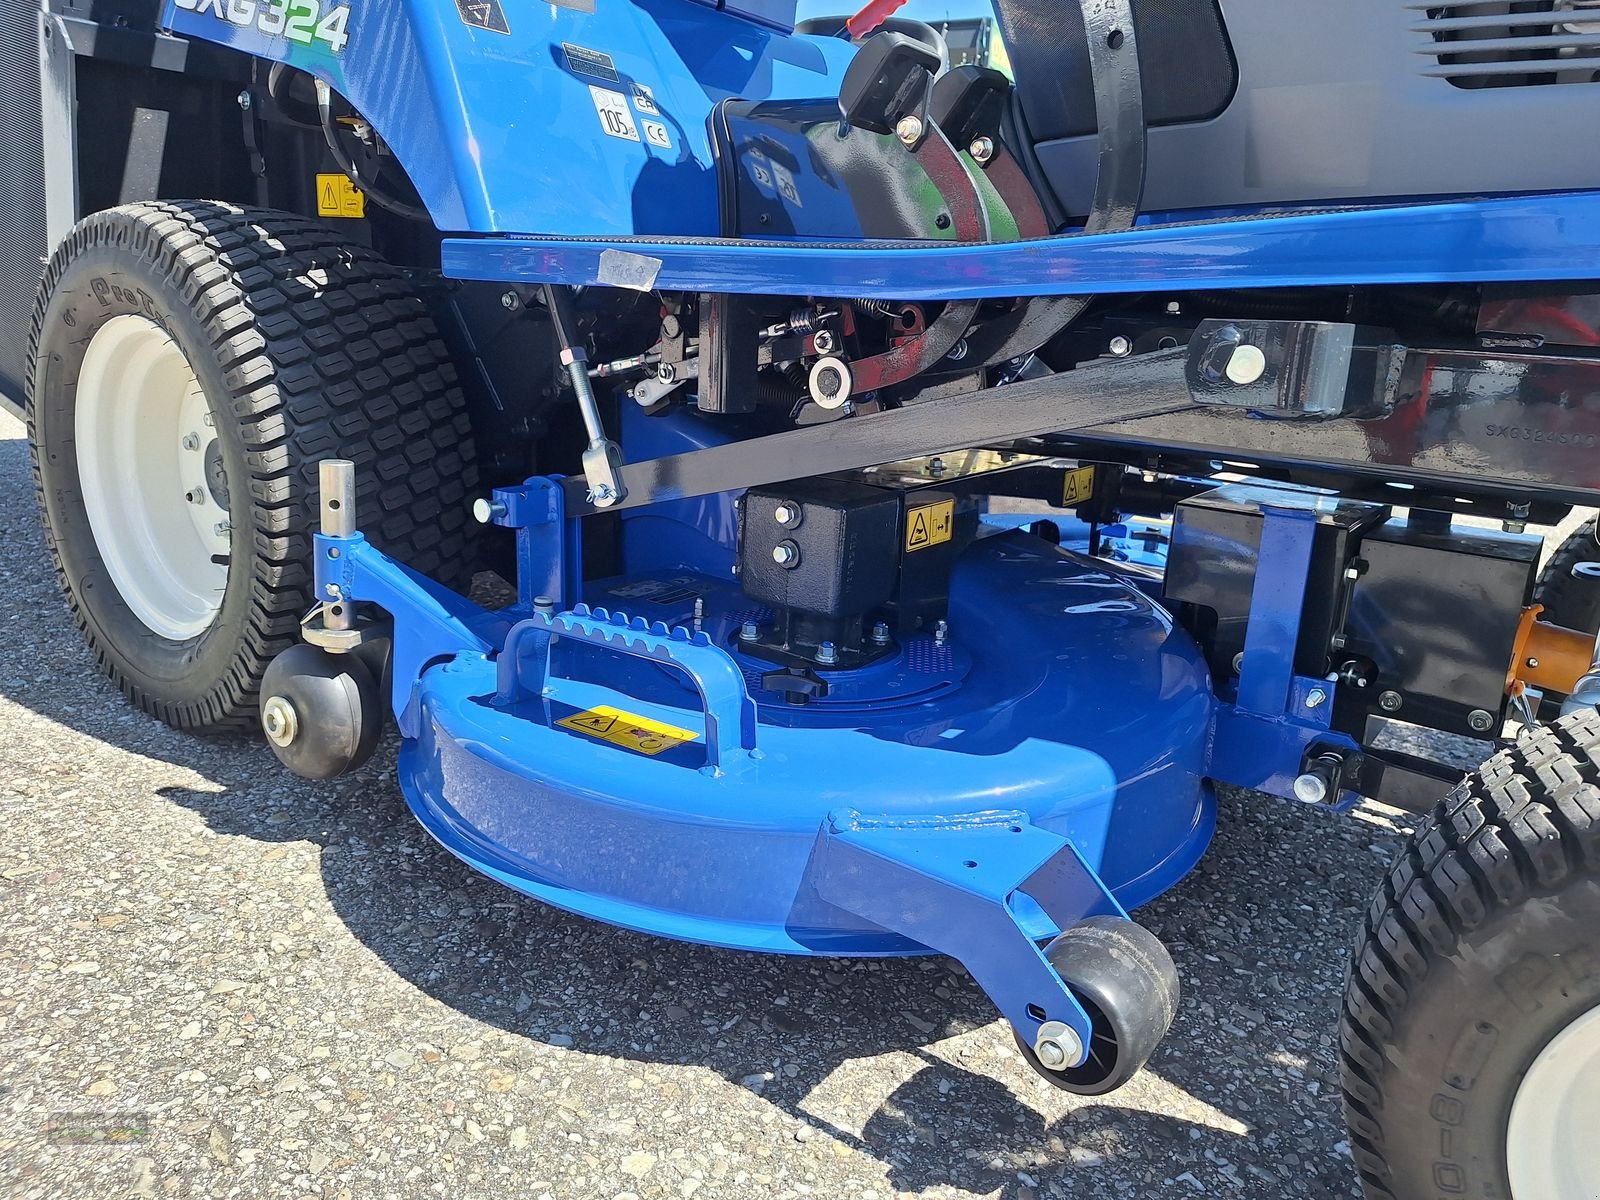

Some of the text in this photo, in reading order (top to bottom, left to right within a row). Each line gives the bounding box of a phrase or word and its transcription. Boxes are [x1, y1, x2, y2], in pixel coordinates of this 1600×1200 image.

[175, 0, 351, 52] G324
[600, 108, 628, 135] 105
[647, 125, 667, 143] CE
